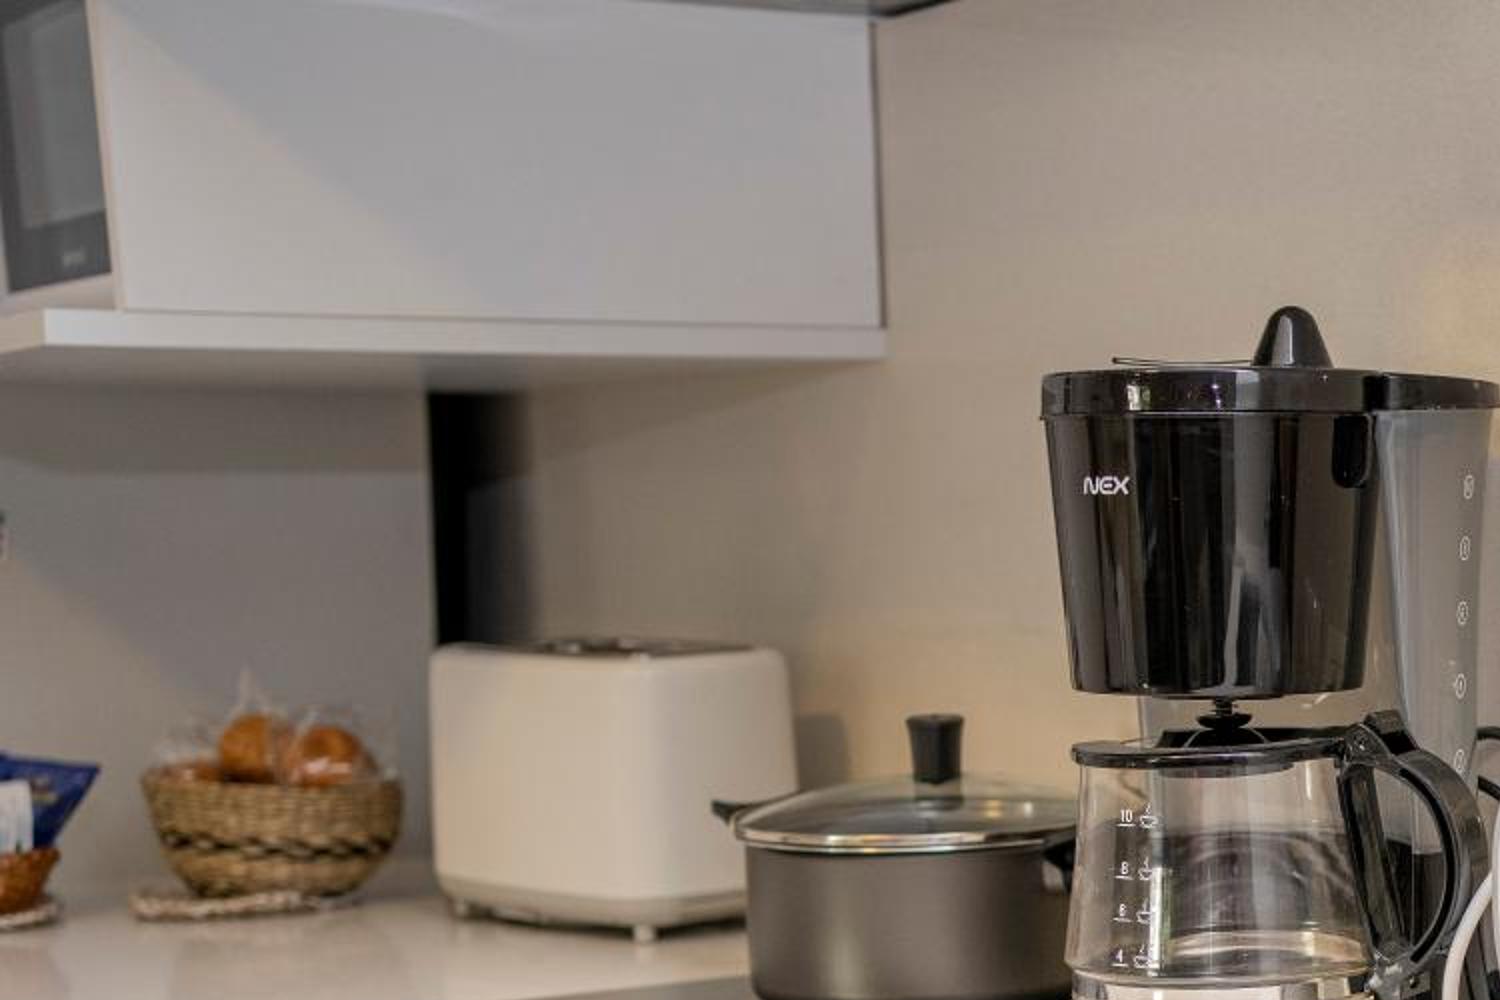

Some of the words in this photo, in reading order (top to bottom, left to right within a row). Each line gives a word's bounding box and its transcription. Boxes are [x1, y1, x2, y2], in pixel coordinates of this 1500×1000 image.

[1083, 476, 1130, 495] NEX
[1121, 809, 1133, 823] 10
[1121, 861, 1129, 875] 8
[1115, 949, 1123, 963] 4
